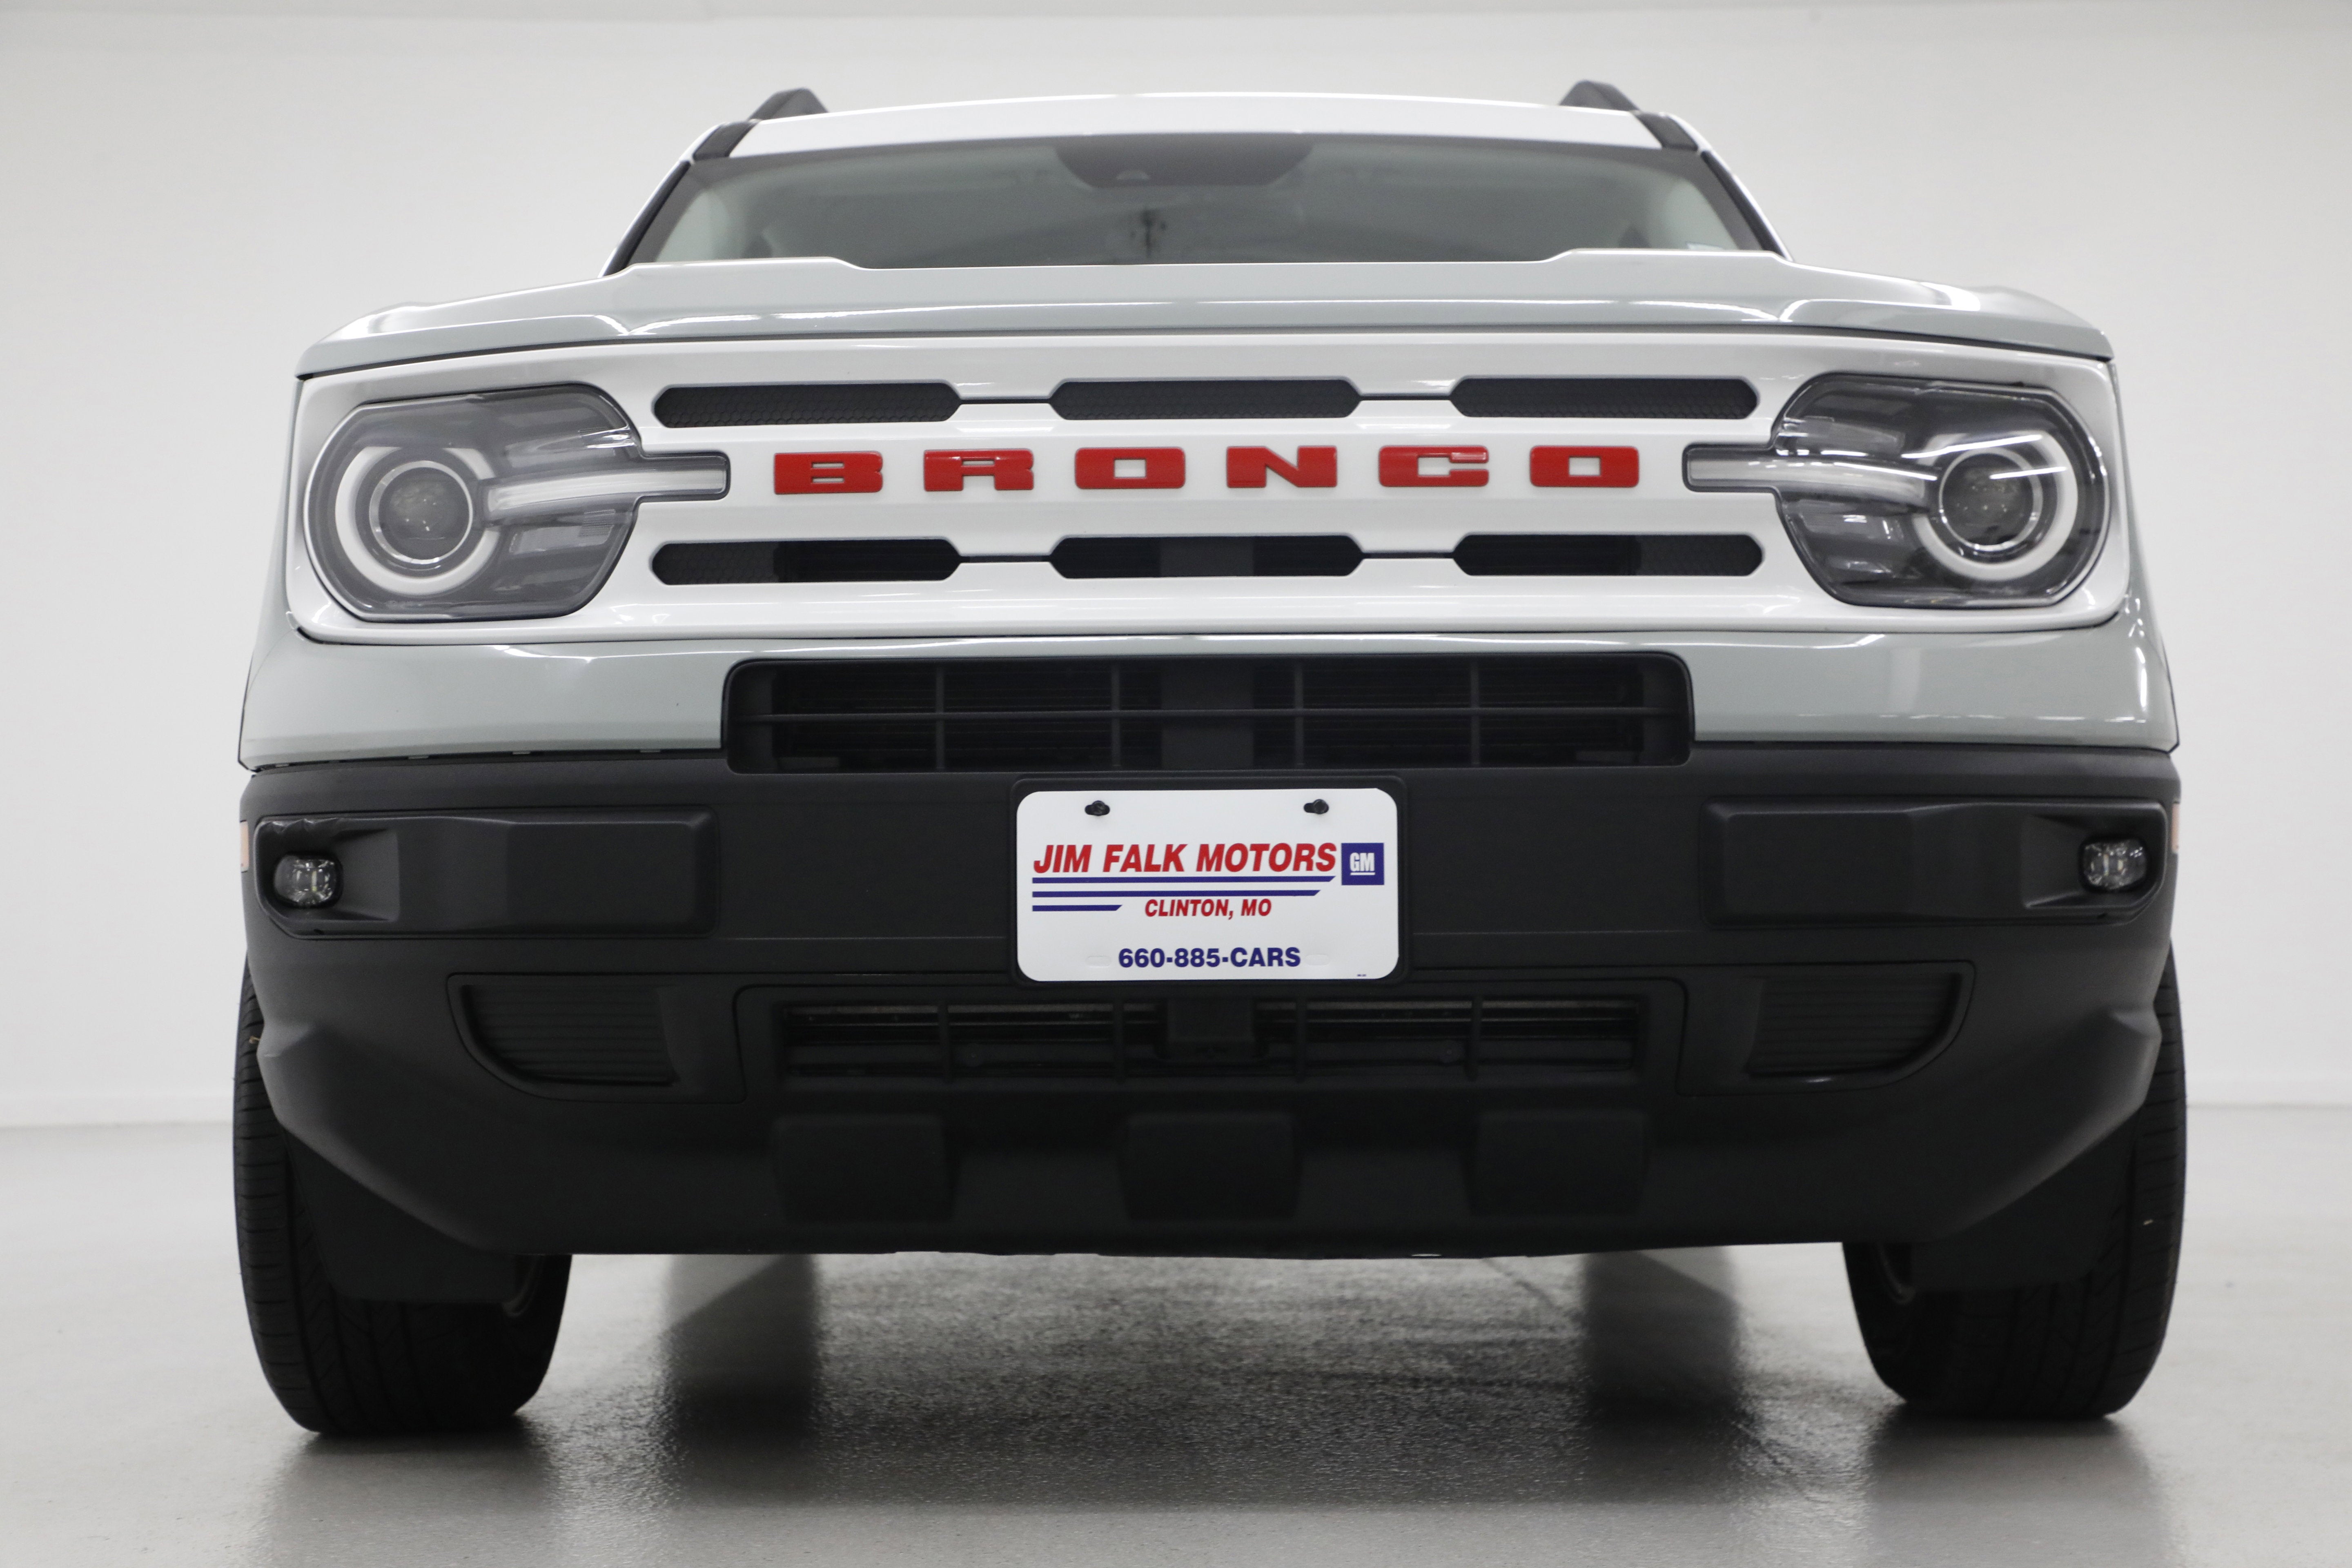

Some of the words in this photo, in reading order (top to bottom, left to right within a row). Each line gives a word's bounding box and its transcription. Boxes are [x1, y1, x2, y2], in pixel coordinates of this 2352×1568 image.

[774, 446, 1639, 494] BRONCO
[1033, 844, 1092, 873] JIM
[1102, 844, 1187, 873] FALK
[1196, 842, 1337, 872] MOTORS
[1350, 852, 1375, 872] GM
[1145, 899, 1233, 920] CLINTON,
[1241, 898, 1272, 916] MO
[1118, 947, 1301, 967] 660-885-CARS
